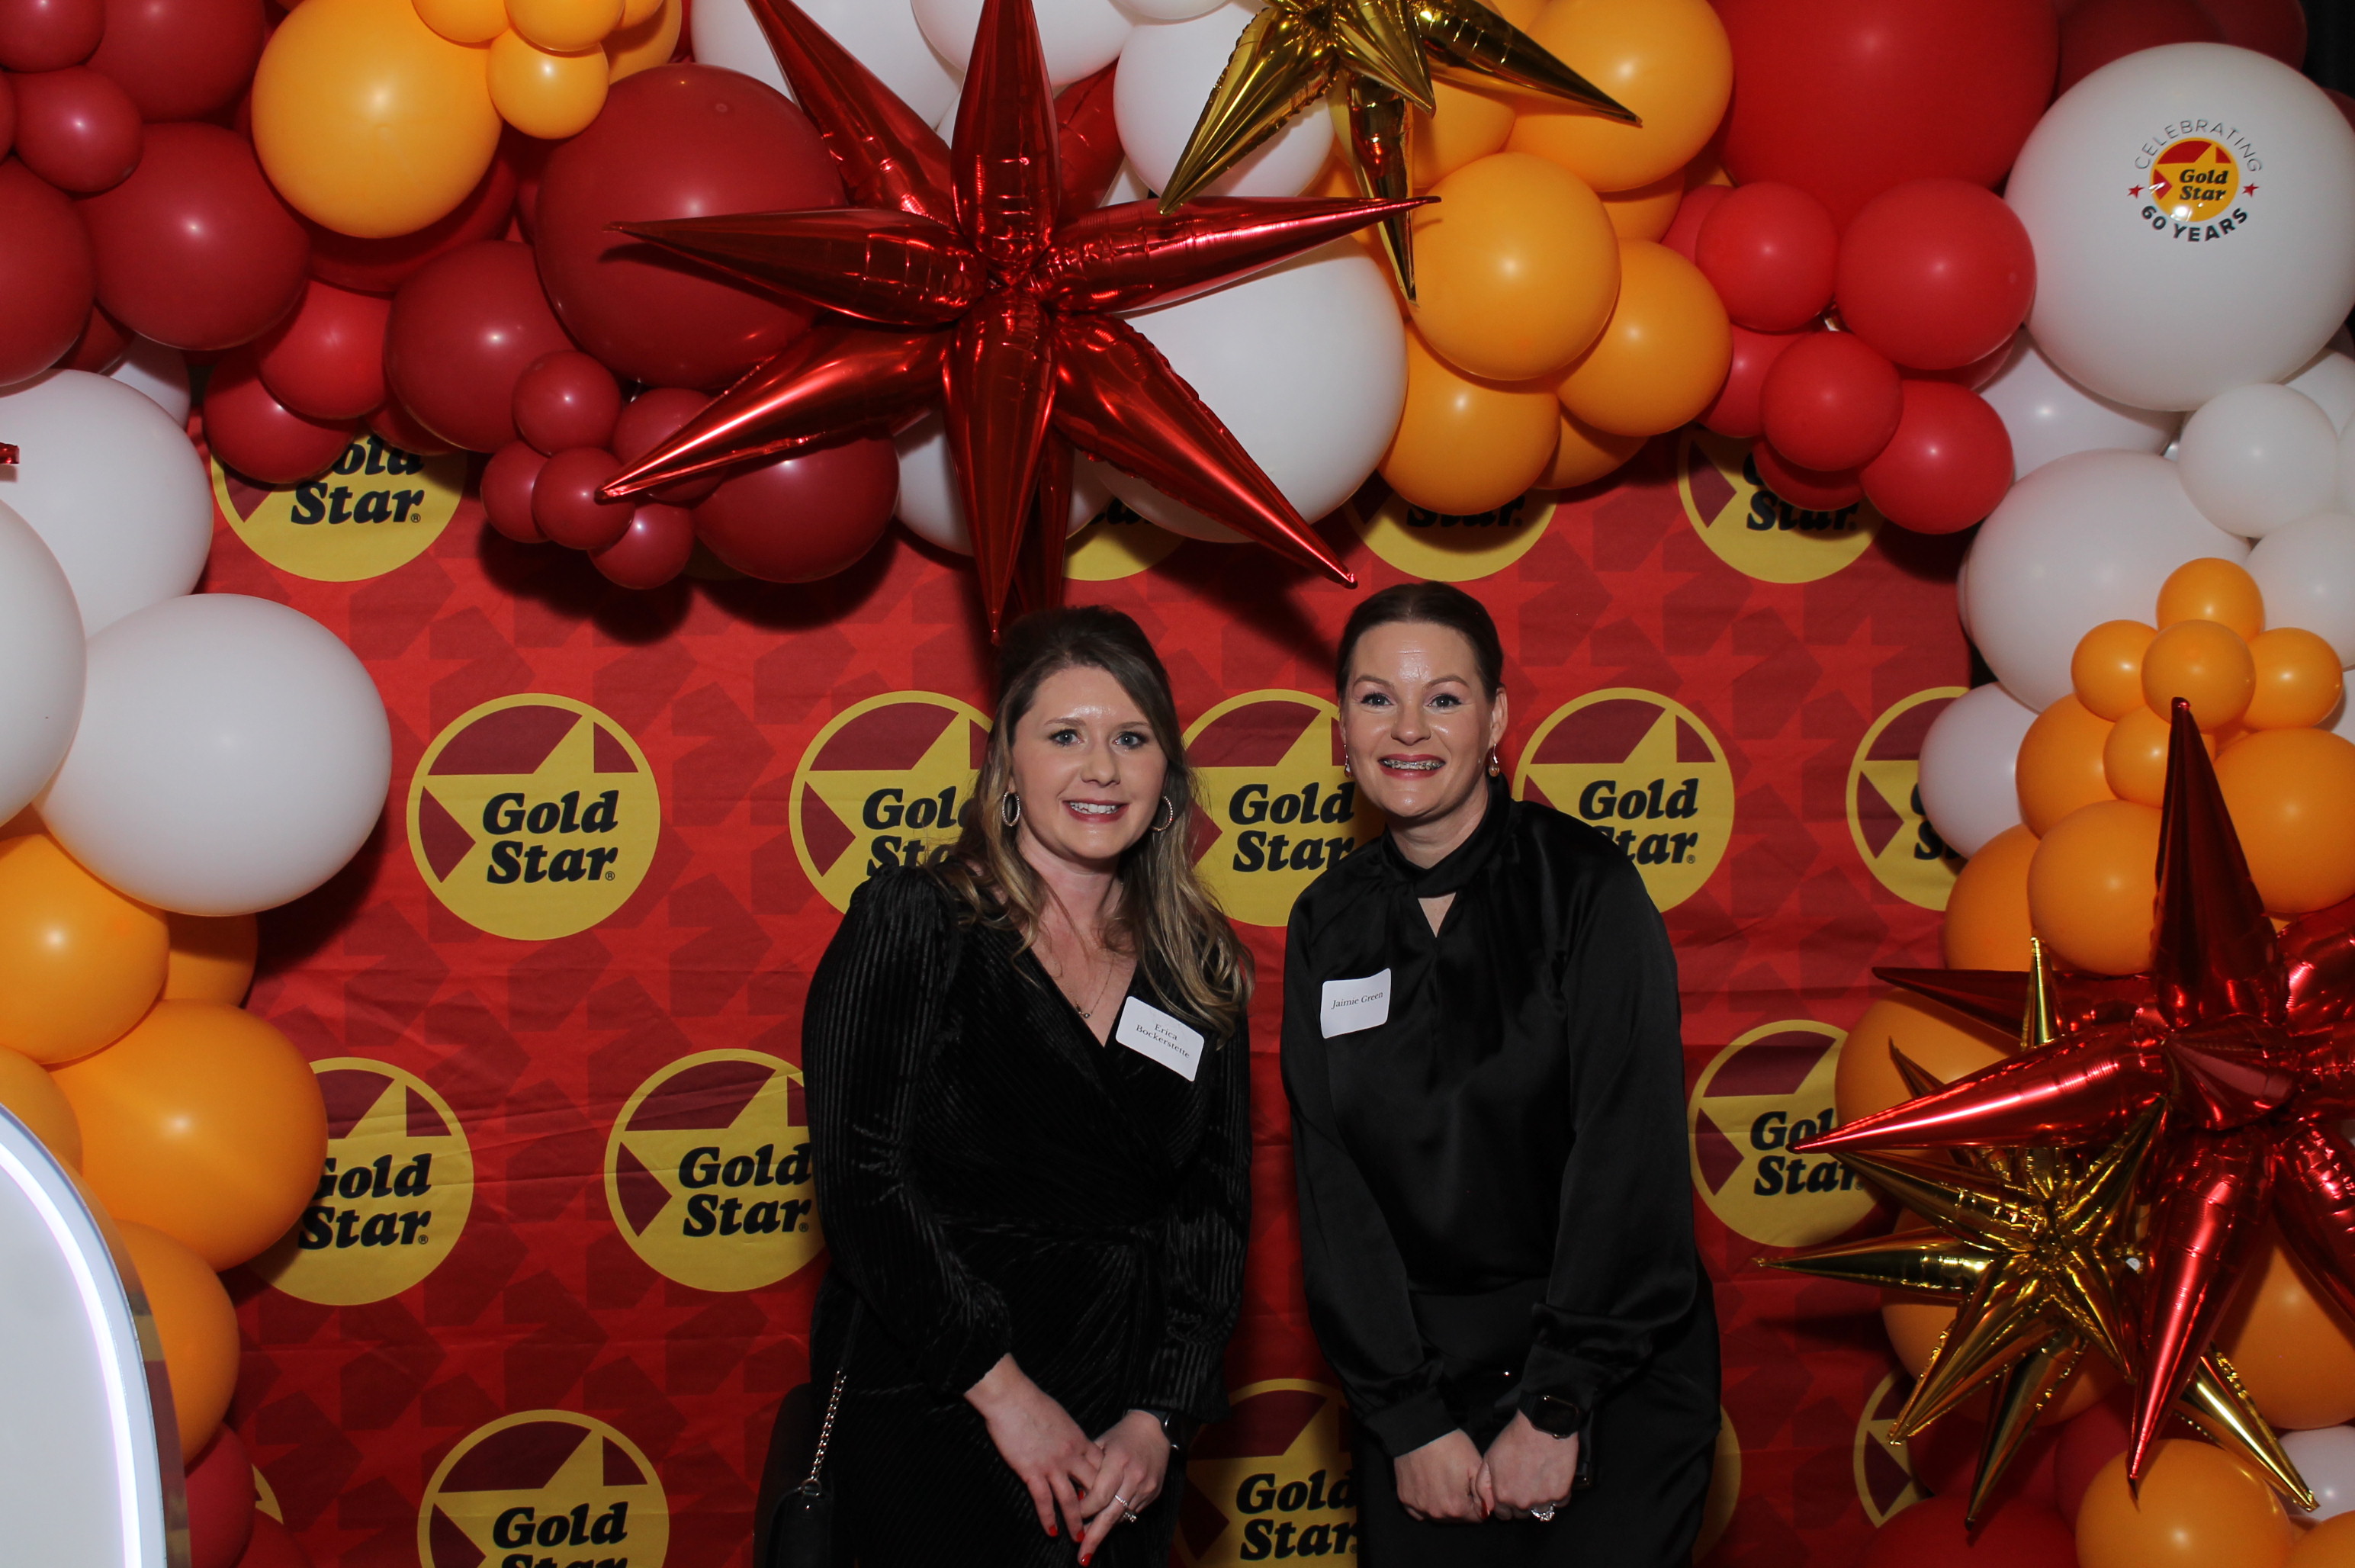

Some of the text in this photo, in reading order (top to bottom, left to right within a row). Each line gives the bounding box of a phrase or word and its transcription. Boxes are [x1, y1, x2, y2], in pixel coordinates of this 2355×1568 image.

[2135, 119, 2263, 172] CELEBRATING
[2180, 169, 2229, 185] Gold
[2180, 185, 2227, 201] Star
[2141, 205, 2248, 242] 60 YEARS
[333, 435, 425, 476] old
[482, 789, 619, 835] Gold
[1229, 782, 1356, 825] Gold
[1579, 778, 1699, 821] Gold
[1232, 830, 1355, 872] Star
[1331, 991, 1383, 1010] Jaimie Green
[1154, 1023, 1178, 1041] Erica
[1750, 1107, 1834, 1151] Gol
[678, 1142, 812, 1189] Gold
[1236, 1469, 1359, 1514] Gold
[493, 1501, 628, 1549] Gold
